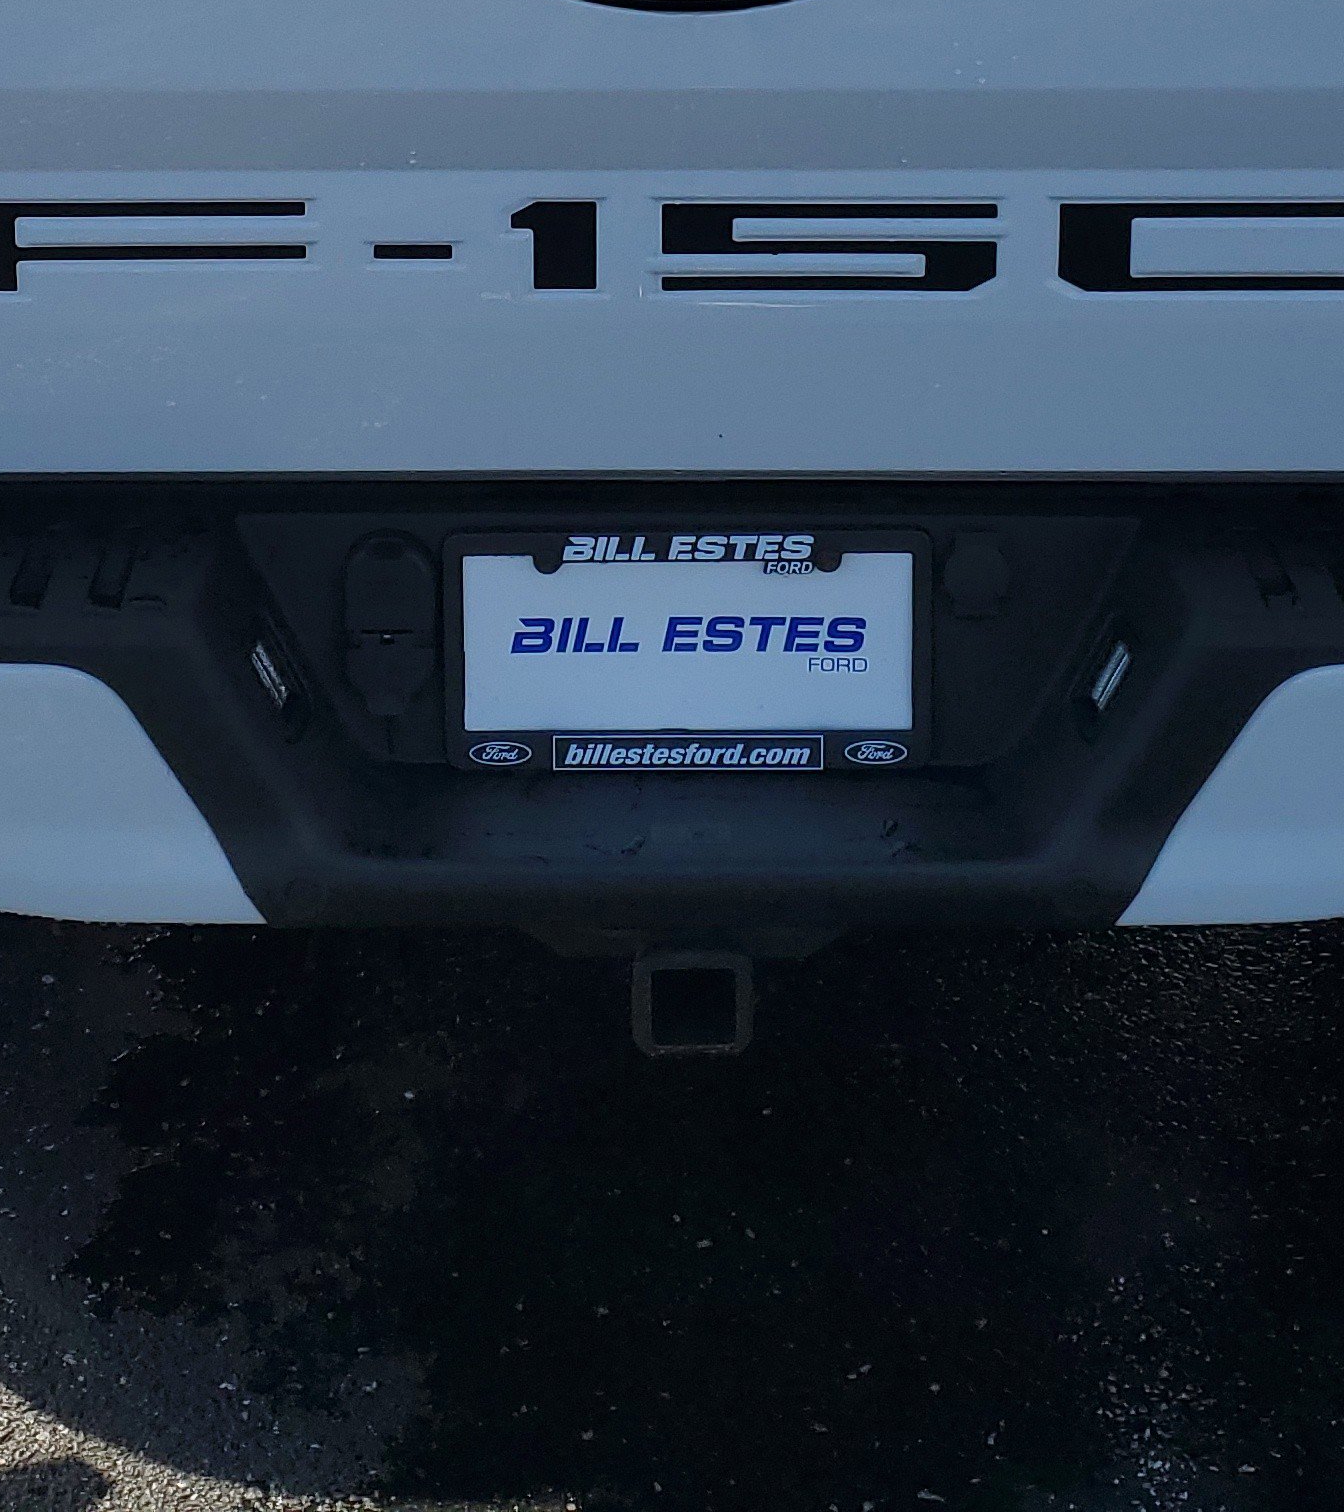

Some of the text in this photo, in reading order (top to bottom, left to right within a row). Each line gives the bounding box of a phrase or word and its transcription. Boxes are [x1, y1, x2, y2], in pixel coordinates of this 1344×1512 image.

[562, 535, 814, 561] BILL ESTES
[765, 561, 813, 575] FORD
[510, 615, 868, 654] BILL ESTES
[808, 656, 868, 673] FORD
[481, 745, 519, 761] Ford
[564, 742, 811, 766] billestesford.com
[857, 743, 894, 760] Ford
